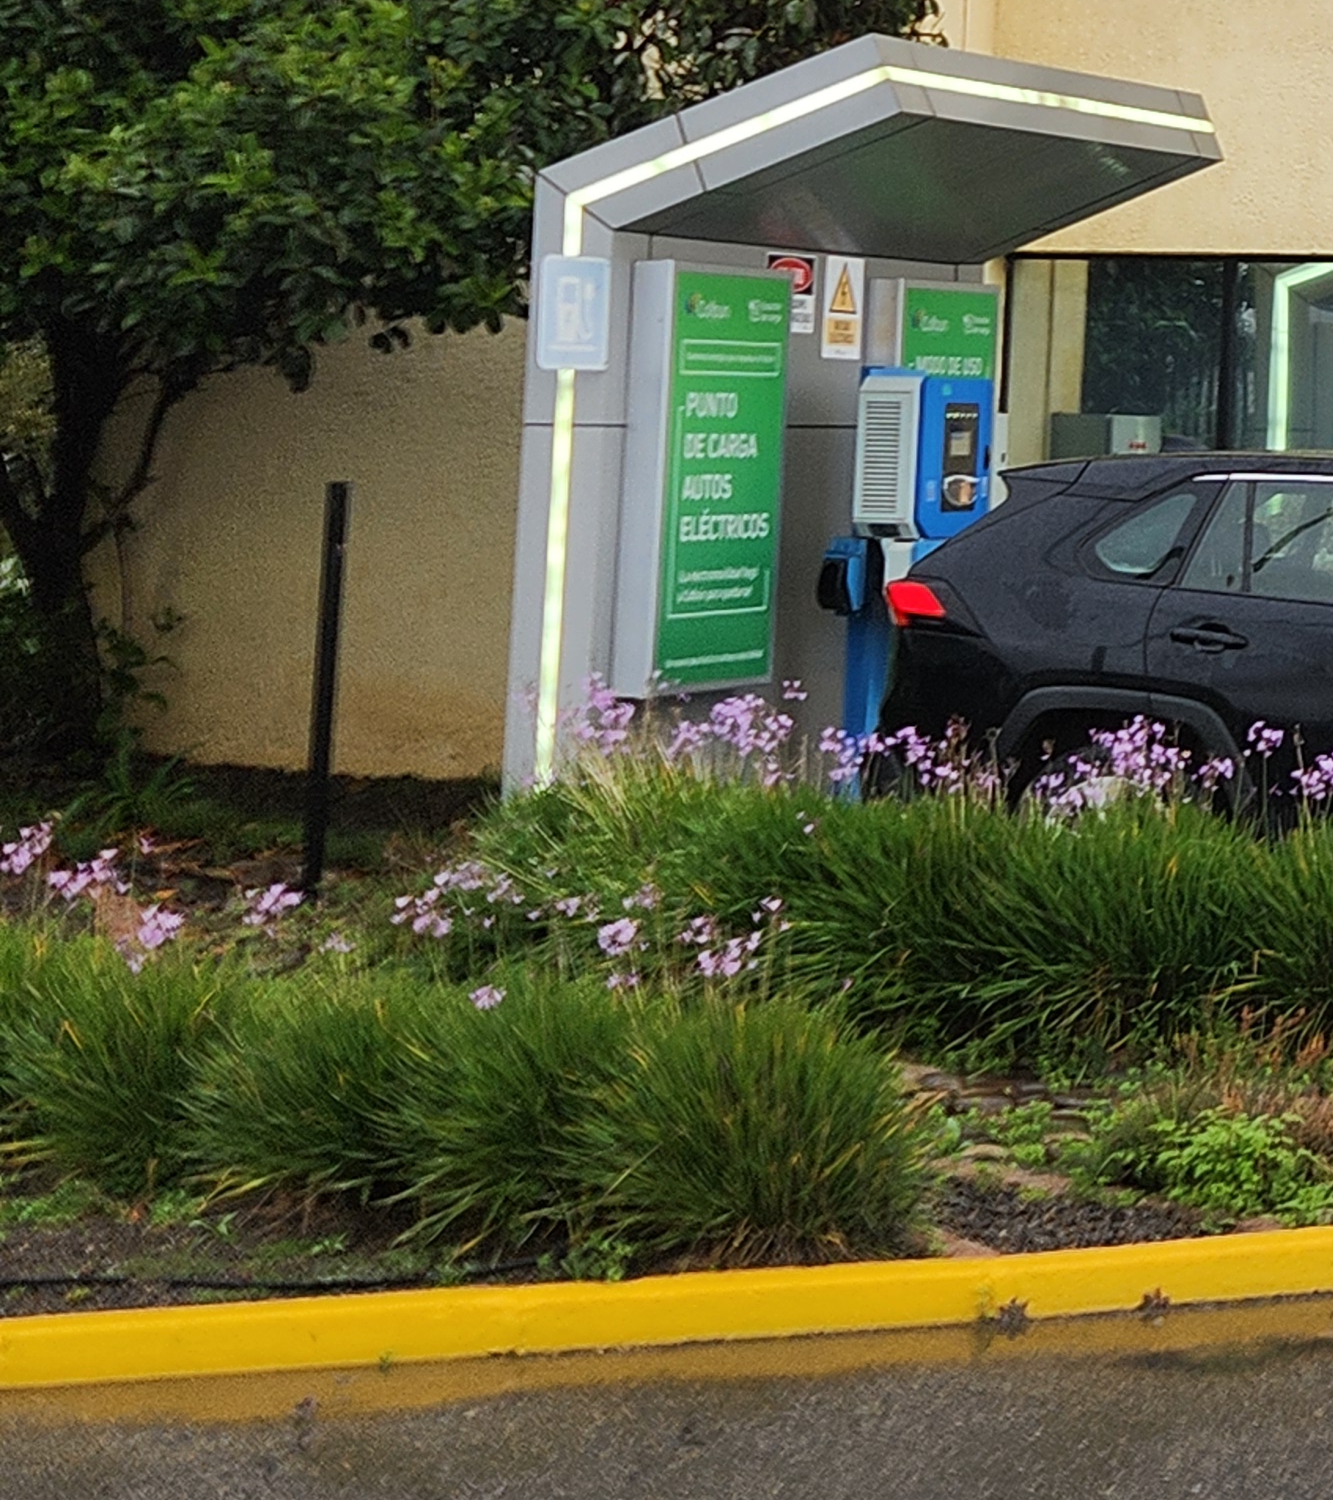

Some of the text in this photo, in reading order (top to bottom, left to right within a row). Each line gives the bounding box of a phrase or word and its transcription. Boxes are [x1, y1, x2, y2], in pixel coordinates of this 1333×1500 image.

[685, 391, 738, 419] PUNTO
[683, 432, 759, 459] DE CARGA
[681, 473, 733, 500] AUTOS
[679, 507, 770, 543] ELÉCTRICOS
